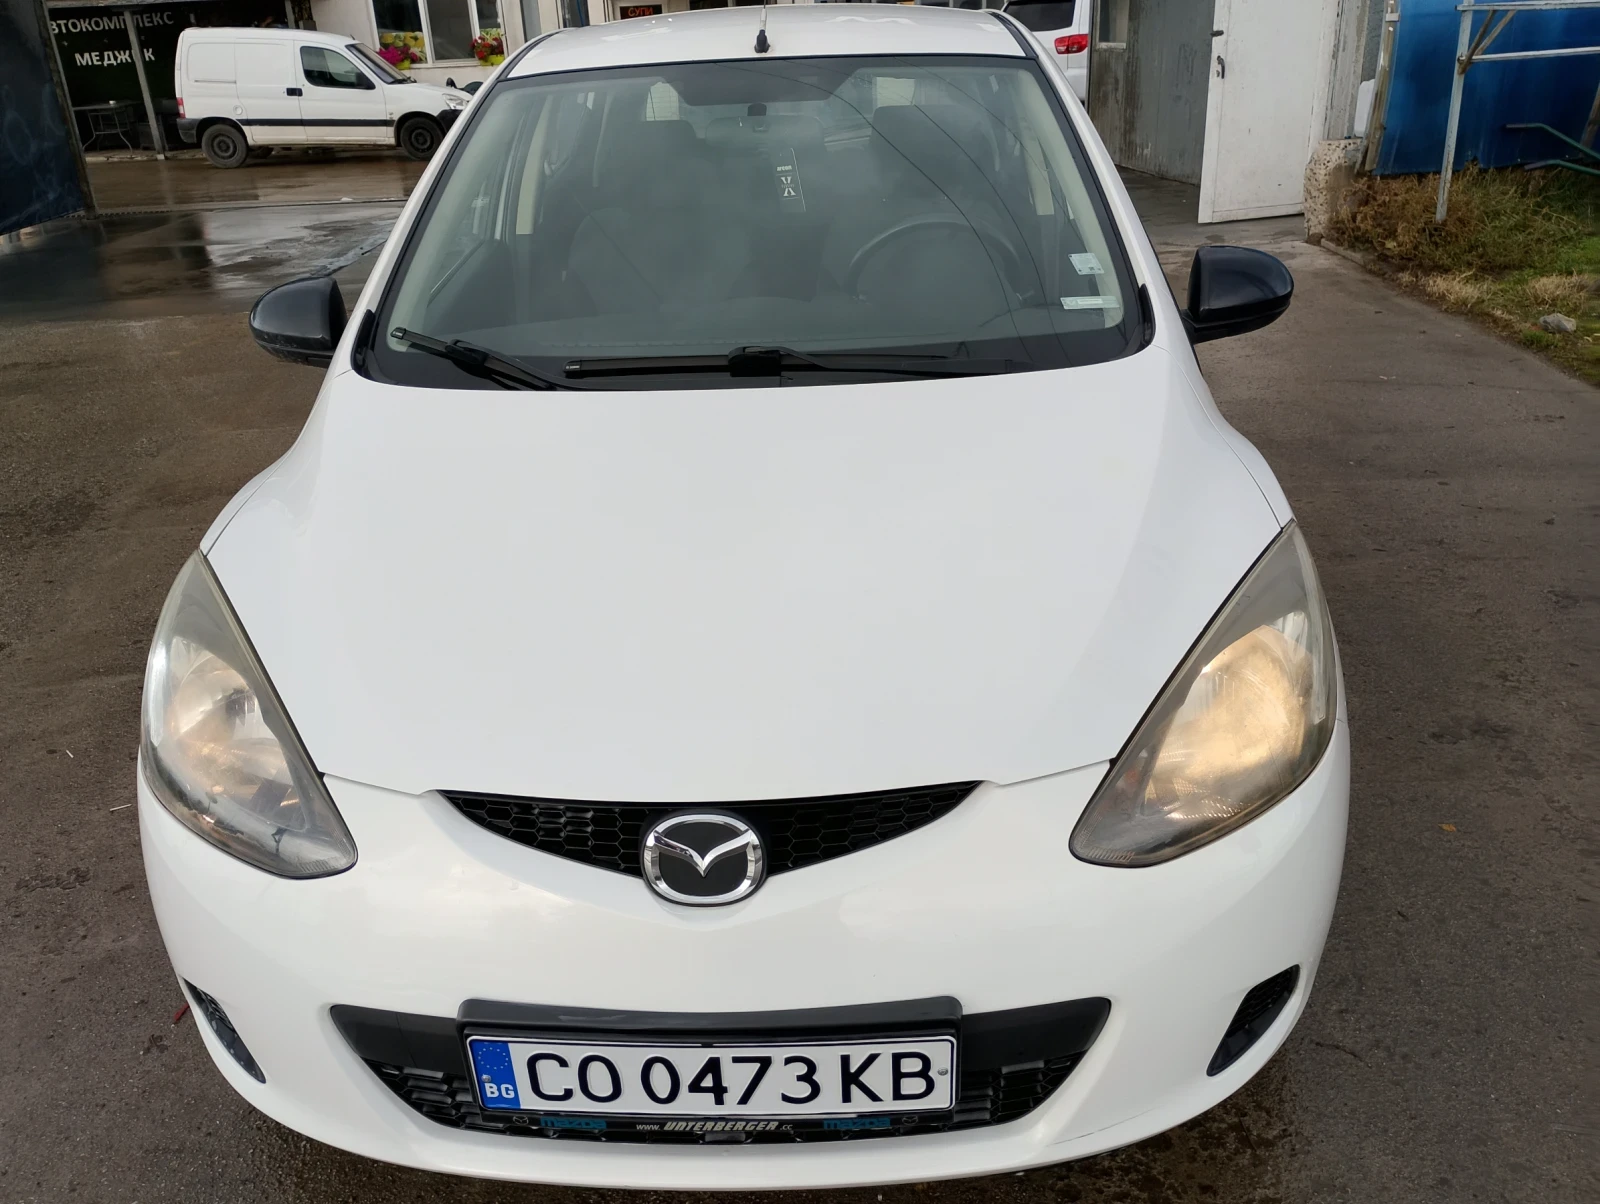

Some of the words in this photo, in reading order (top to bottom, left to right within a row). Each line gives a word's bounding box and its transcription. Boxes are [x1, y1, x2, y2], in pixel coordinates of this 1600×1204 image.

[49, 11, 175, 34] ВТОКОМПЛЕКС
[74, 47, 156, 67] МЕДЖК
[526, 1051, 624, 1104] CO
[640, 1052, 823, 1106] 0473
[838, 1051, 937, 1104] KB
[484, 1081, 516, 1100] BG
[539, 1116, 608, 1129] mazda
[823, 1116, 891, 1128] mazda
